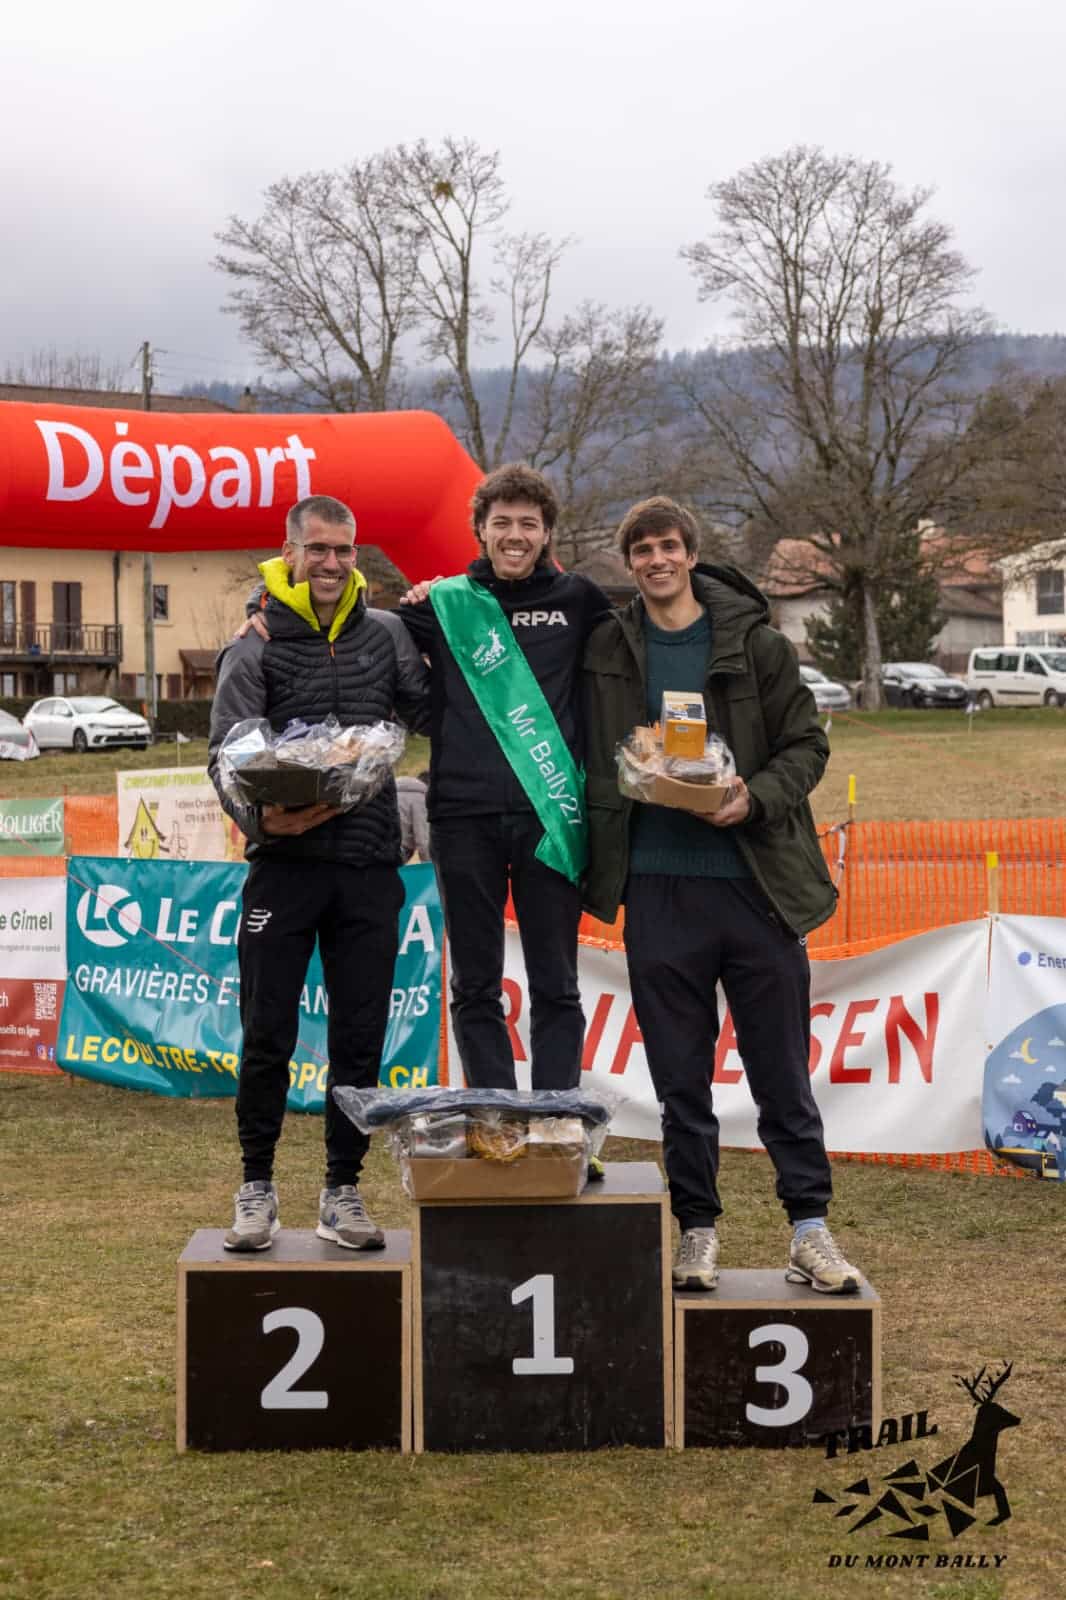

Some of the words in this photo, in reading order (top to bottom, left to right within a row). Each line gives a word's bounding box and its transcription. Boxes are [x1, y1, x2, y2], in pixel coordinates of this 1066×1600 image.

[34, 419, 317, 529] Départ
[512, 610, 568, 626] RPA
[506, 703, 536, 737] Mr
[11, 909, 52, 930] Gimel
[75, 963, 209, 1004] GRAVIÈRES
[260, 1307, 329, 1410] 2
[511, 1274, 574, 1375] 1
[745, 1323, 813, 1427] 3
